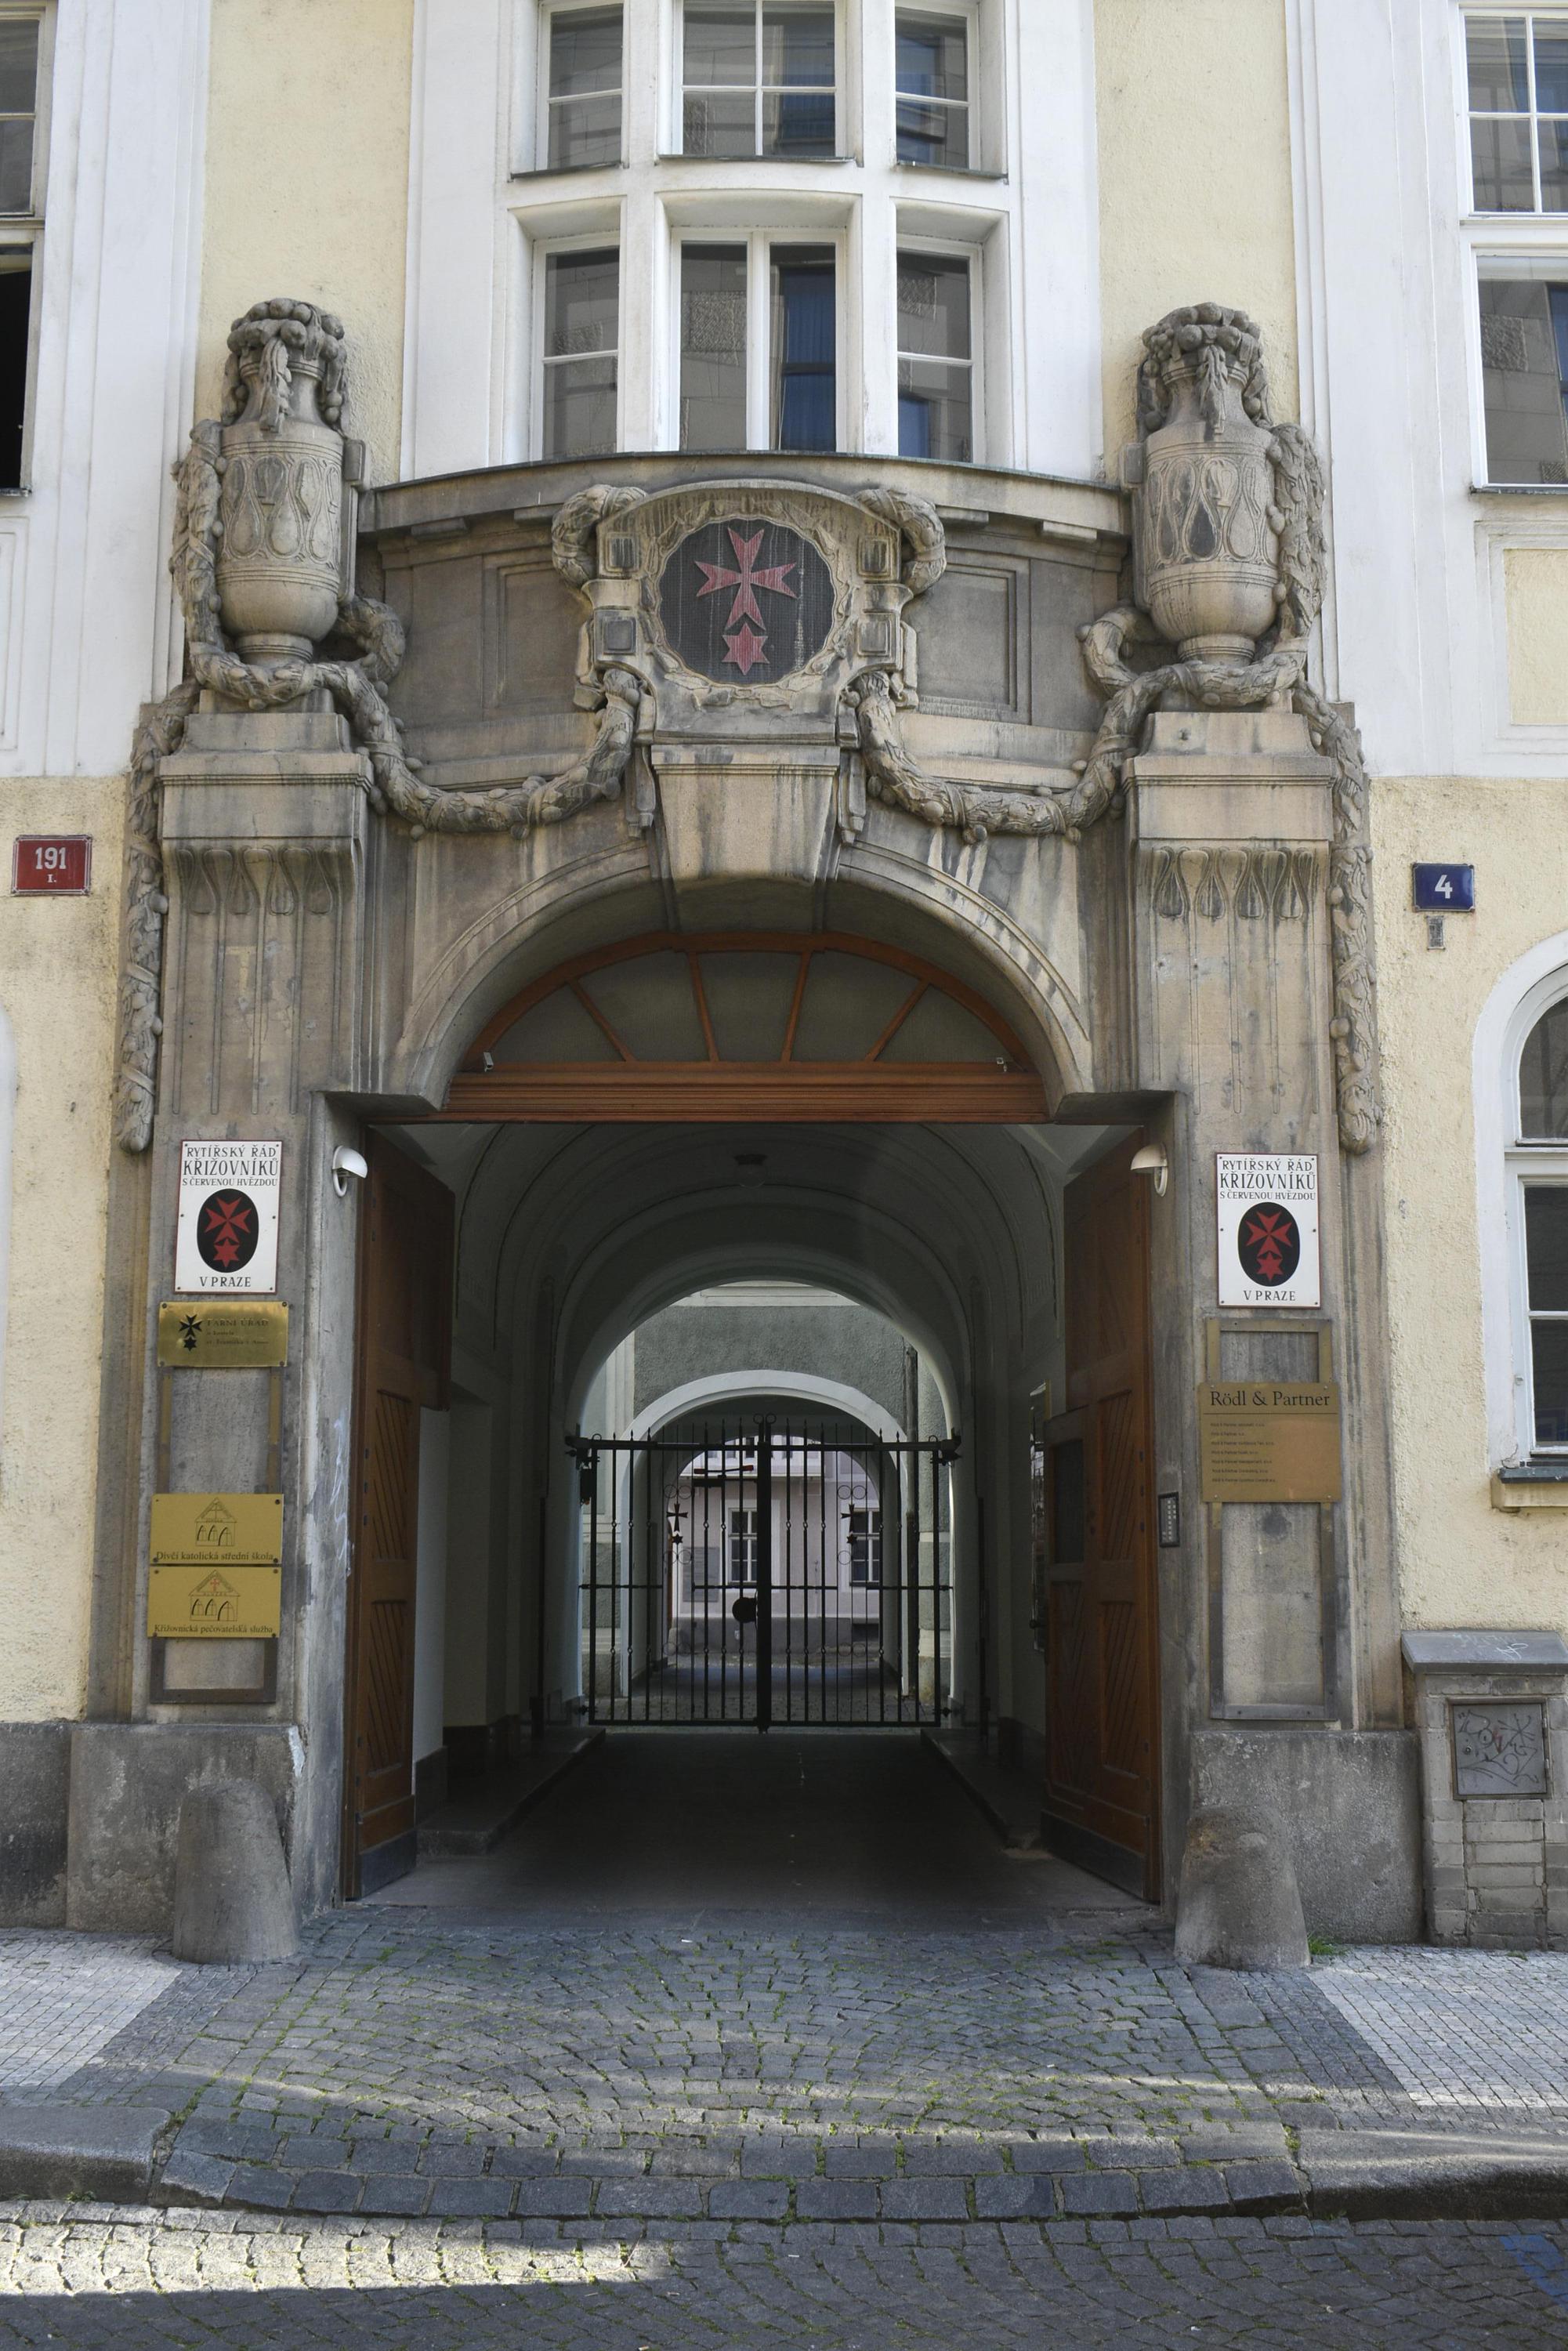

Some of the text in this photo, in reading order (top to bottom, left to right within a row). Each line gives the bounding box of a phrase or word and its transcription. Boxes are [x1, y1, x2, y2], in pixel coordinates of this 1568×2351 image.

[35, 847, 67, 870] 191
[47, 874, 57, 883] I.
[1435, 875, 1454, 900] 4
[186, 1144, 277, 1157] RYTÍŘSKÝ ŘÁD
[183, 1157, 279, 1176] KŘIŽOVNÍKŮ
[1222, 1157, 1313, 1172] RYTÍŘSKÝ ŘÁD
[182, 1176, 278, 1186] S ČERVENOU HVĚZDOU
[1220, 1171, 1316, 1190] KŘIŽOVNÍKŮ
[1227, 1190, 1273, 1200] ČERVENOU
[1275, 1190, 1316, 1201] HVĚZDOU
[199, 1277, 252, 1288] V PRAZE
[1243, 1290, 1296, 1302] V PRAZE
[1210, 1390, 1331, 1406] Rödl & Partner
[181, 1551, 219, 1560] katolická
[221, 1551, 249, 1560] střední
[252, 1552, 273, 1560] škola
[250, 1625, 273, 1634] služba
